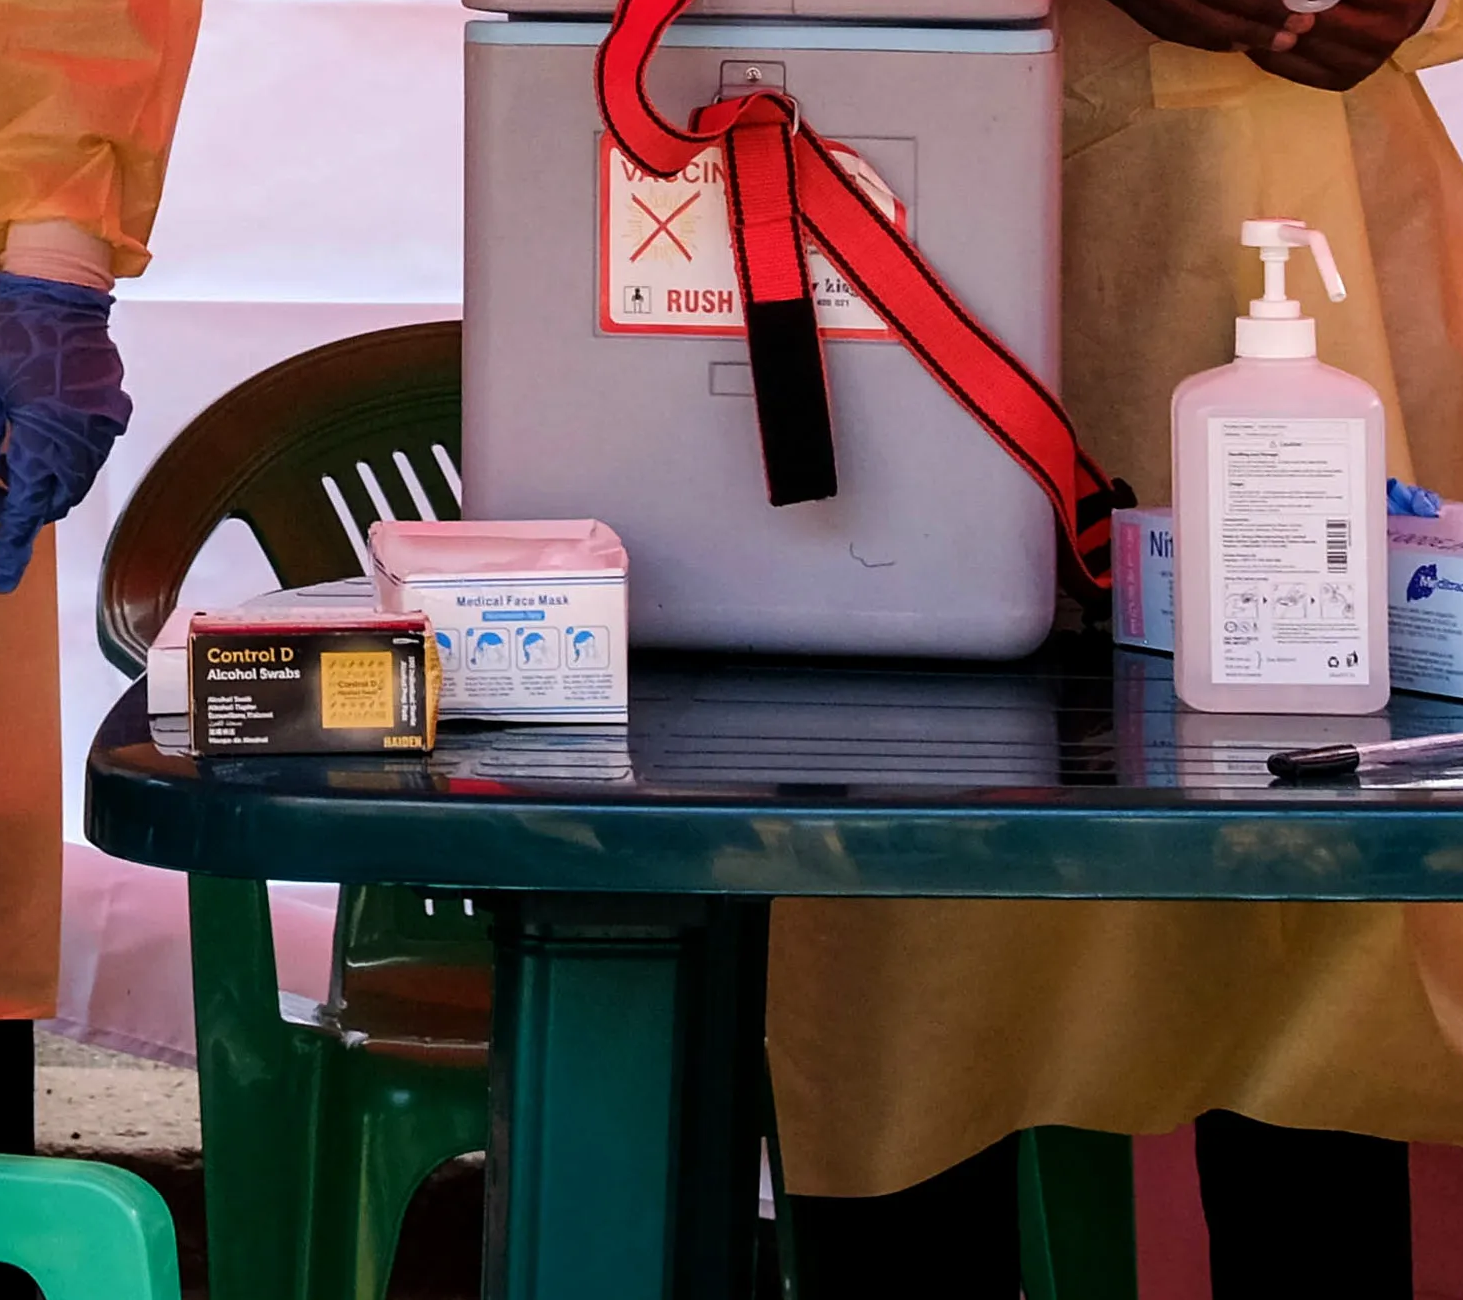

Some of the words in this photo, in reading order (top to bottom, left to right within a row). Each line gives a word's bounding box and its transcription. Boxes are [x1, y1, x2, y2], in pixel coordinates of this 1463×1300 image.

[667, 289, 734, 314] RUSH
[456, 595, 504, 607] Medical
[506, 595, 535, 607] Face
[538, 594, 570, 606] Mask
[207, 647, 276, 664] Control
[280, 647, 294, 663] D
[206, 667, 257, 681] Alcohol
[259, 667, 301, 681] Swabs
